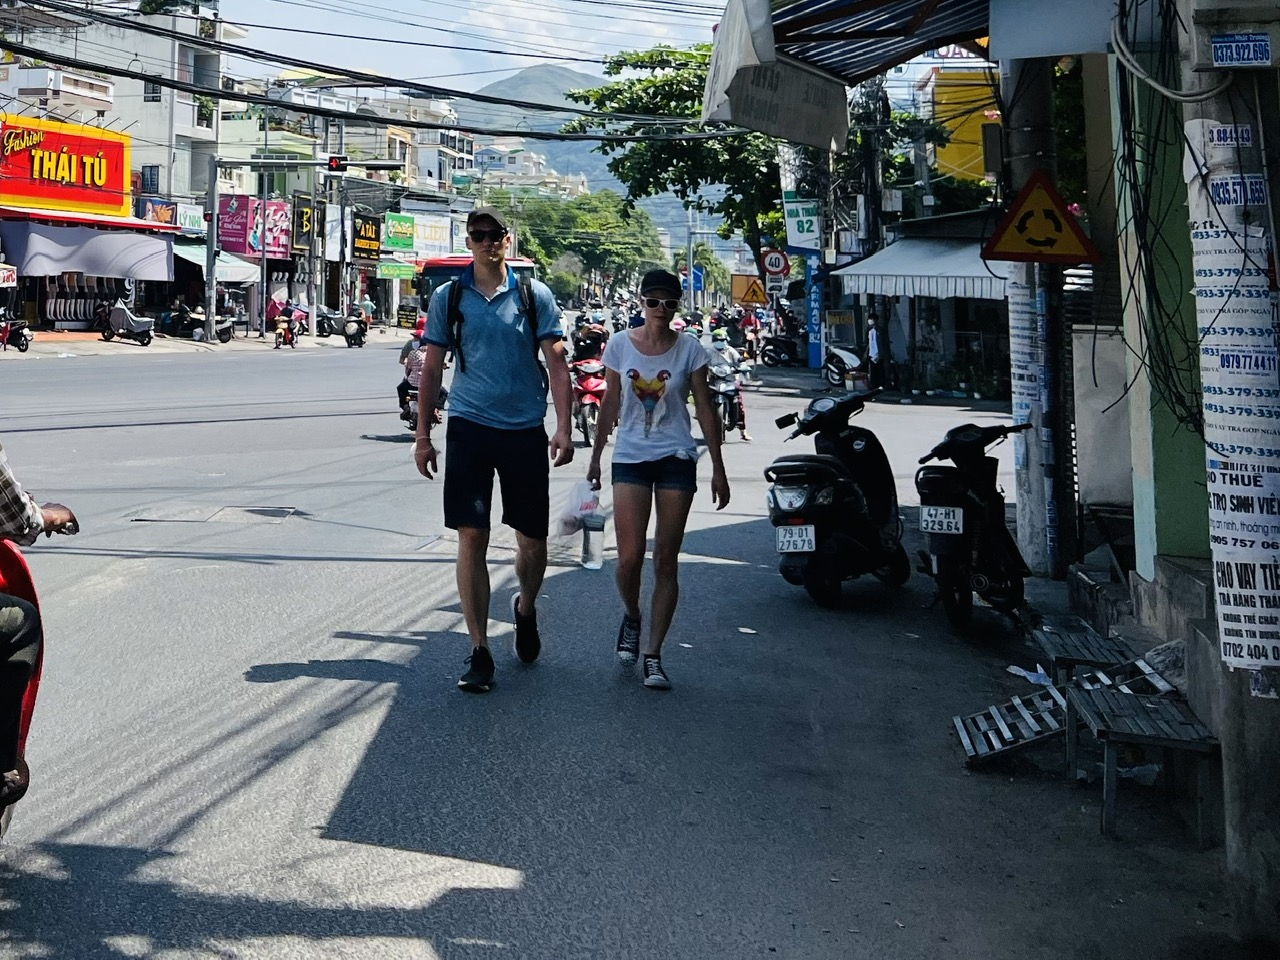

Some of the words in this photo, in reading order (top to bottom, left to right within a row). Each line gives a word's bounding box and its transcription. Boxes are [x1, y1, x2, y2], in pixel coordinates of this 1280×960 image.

[1213, 43, 1269, 62] 0373.922.696
[4, 128, 45, 155] Fashion
[31, 146, 77, 182] THÁI
[83, 151, 107, 186] TÚ
[797, 219, 814, 233] 82
[768, 257, 780, 269] 40
[810, 270, 820, 332] PARMACY
[1220, 472, 1264, 487] THUÊ
[1230, 494, 1255, 514] SINH
[927, 508, 956, 520] 47-H1
[922, 520, 960, 532] 329.64
[1240, 520, 1269, 536] thoáng
[1231, 537, 1256, 549] 757
[1216, 560, 1233, 589] CHO
[1235, 562, 1256, 590] VAY
[1223, 641, 1244, 658] 0702
[1247, 644, 1268, 660] 404
